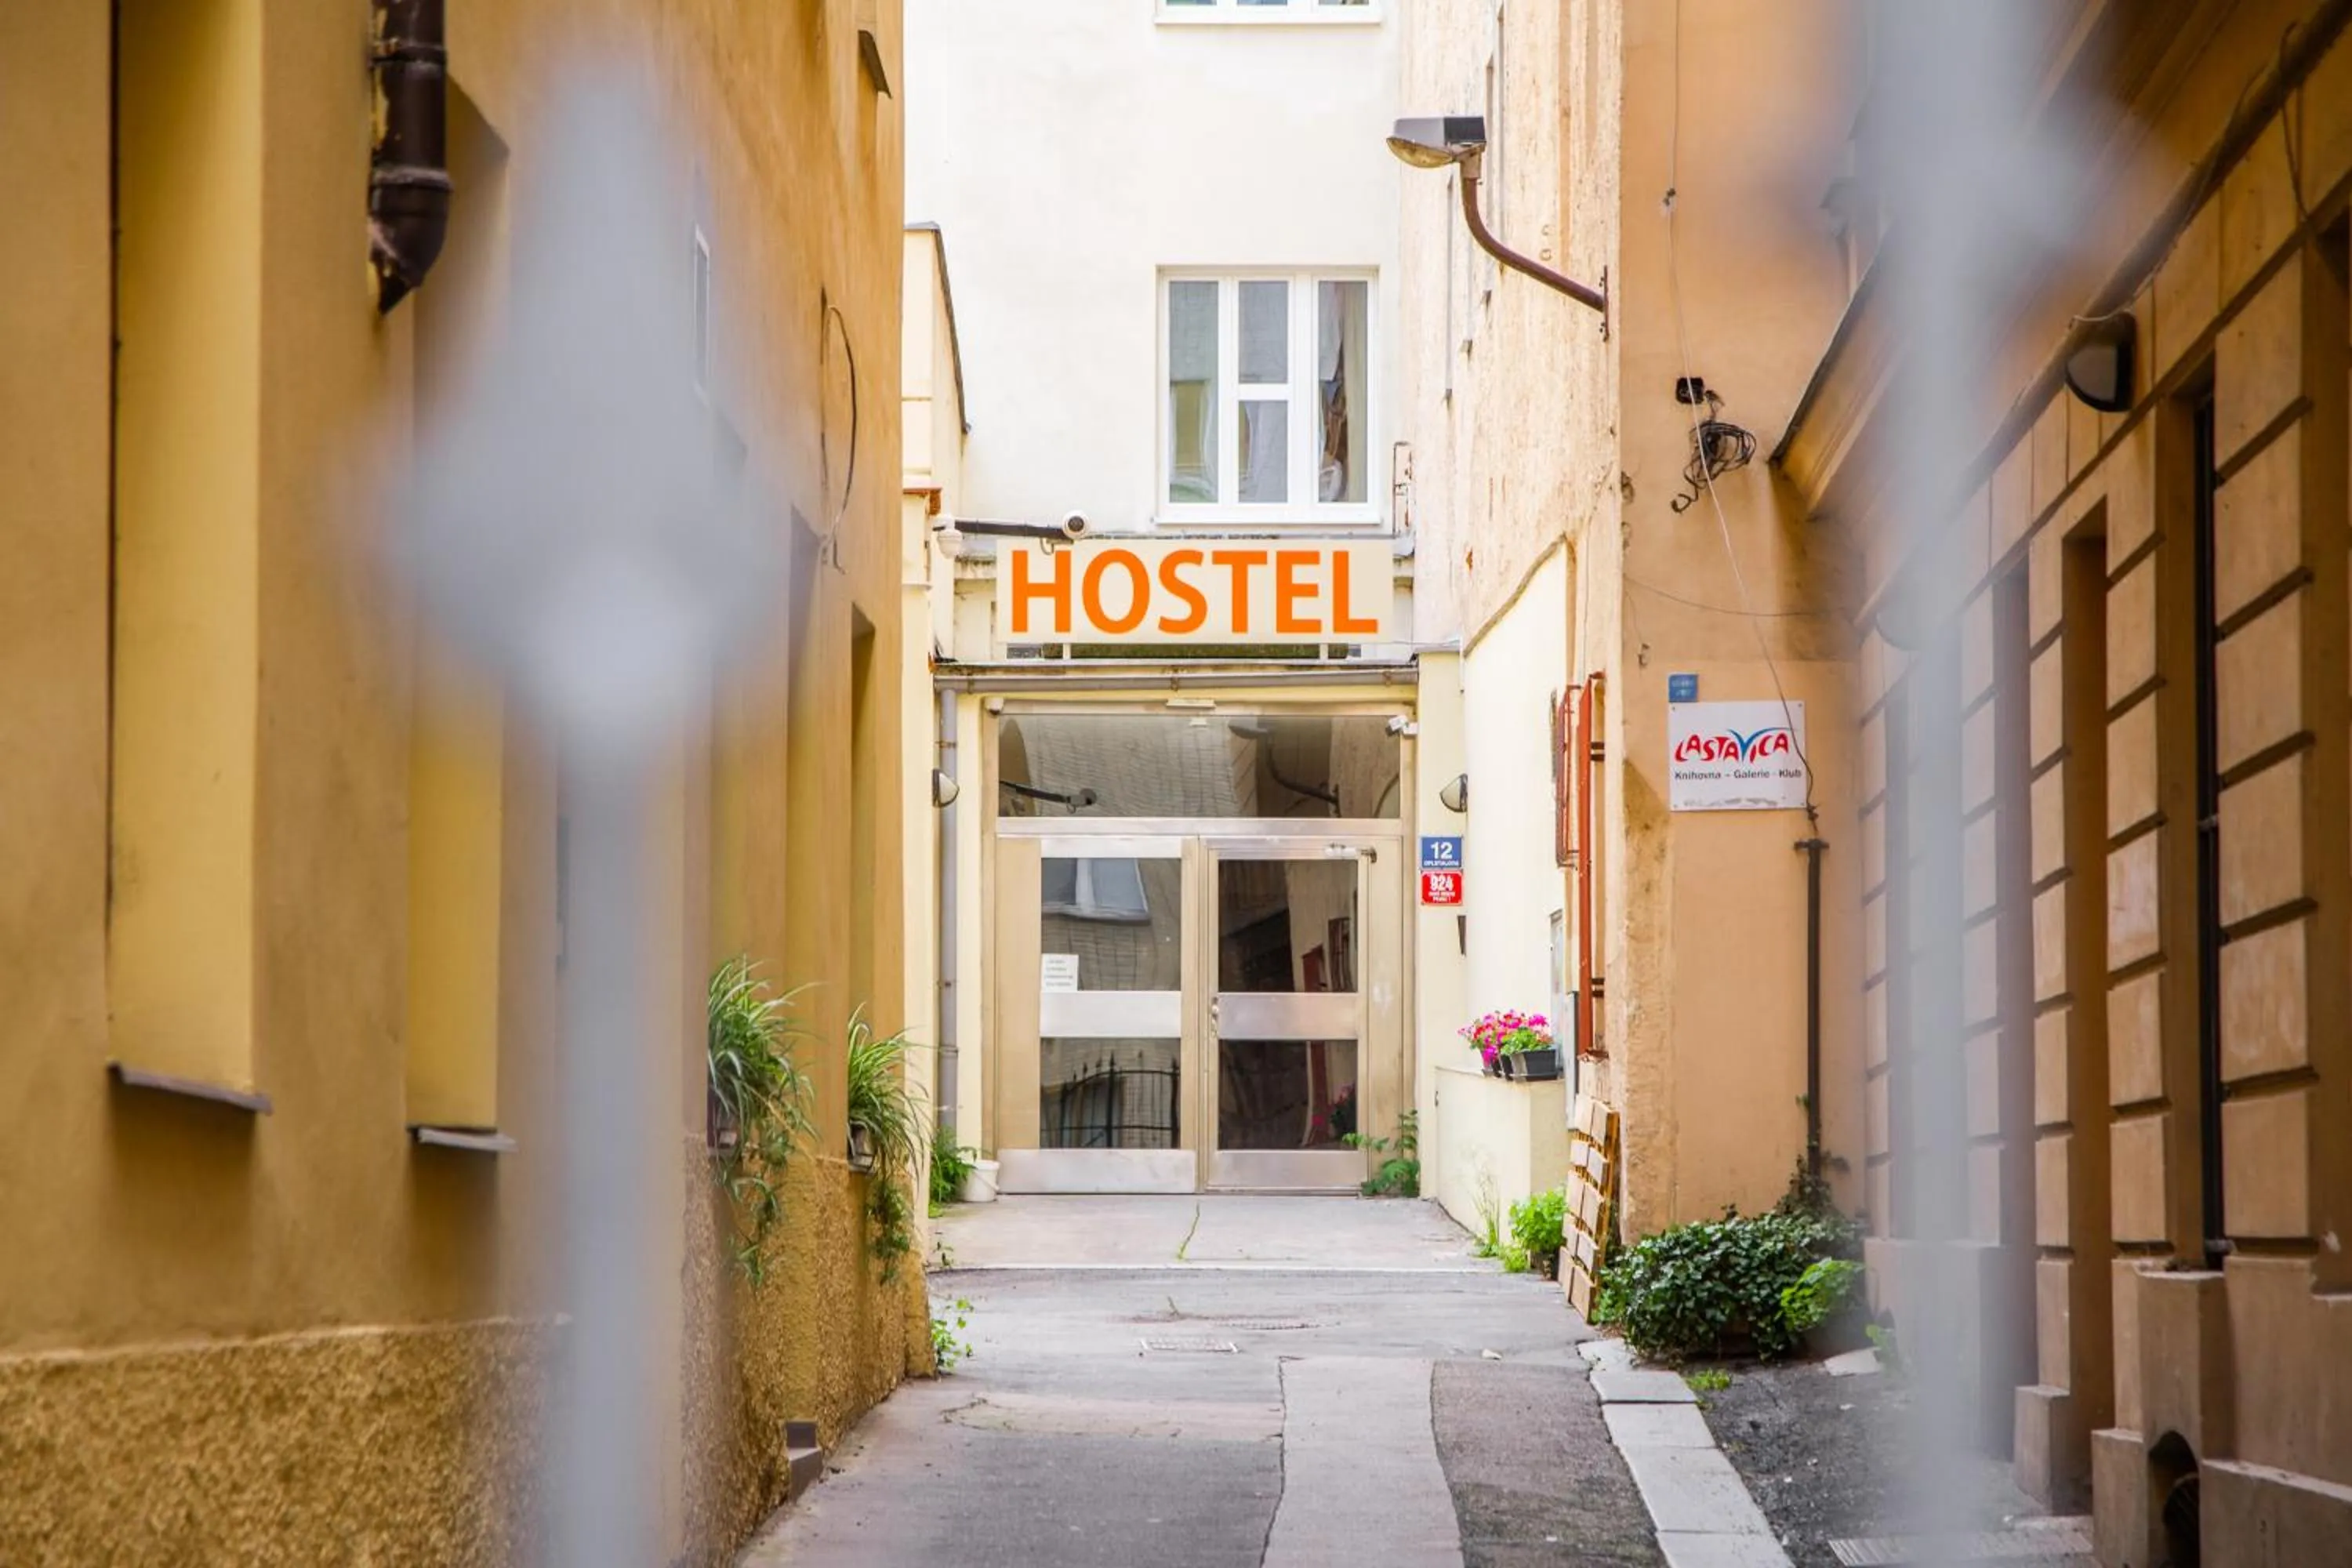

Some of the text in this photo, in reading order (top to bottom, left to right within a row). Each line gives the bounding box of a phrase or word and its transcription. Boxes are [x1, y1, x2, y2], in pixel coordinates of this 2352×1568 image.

[1011, 549, 1378, 633] HOSTEL
[1675, 728, 1795, 764] LASTAVICA
[1675, 770, 1722, 781] Knihovna
[1733, 769, 1770, 779] Galerie
[1779, 768, 1802, 779] Klub
[1431, 841, 1453, 859] 12
[1431, 874, 1454, 891] 924
